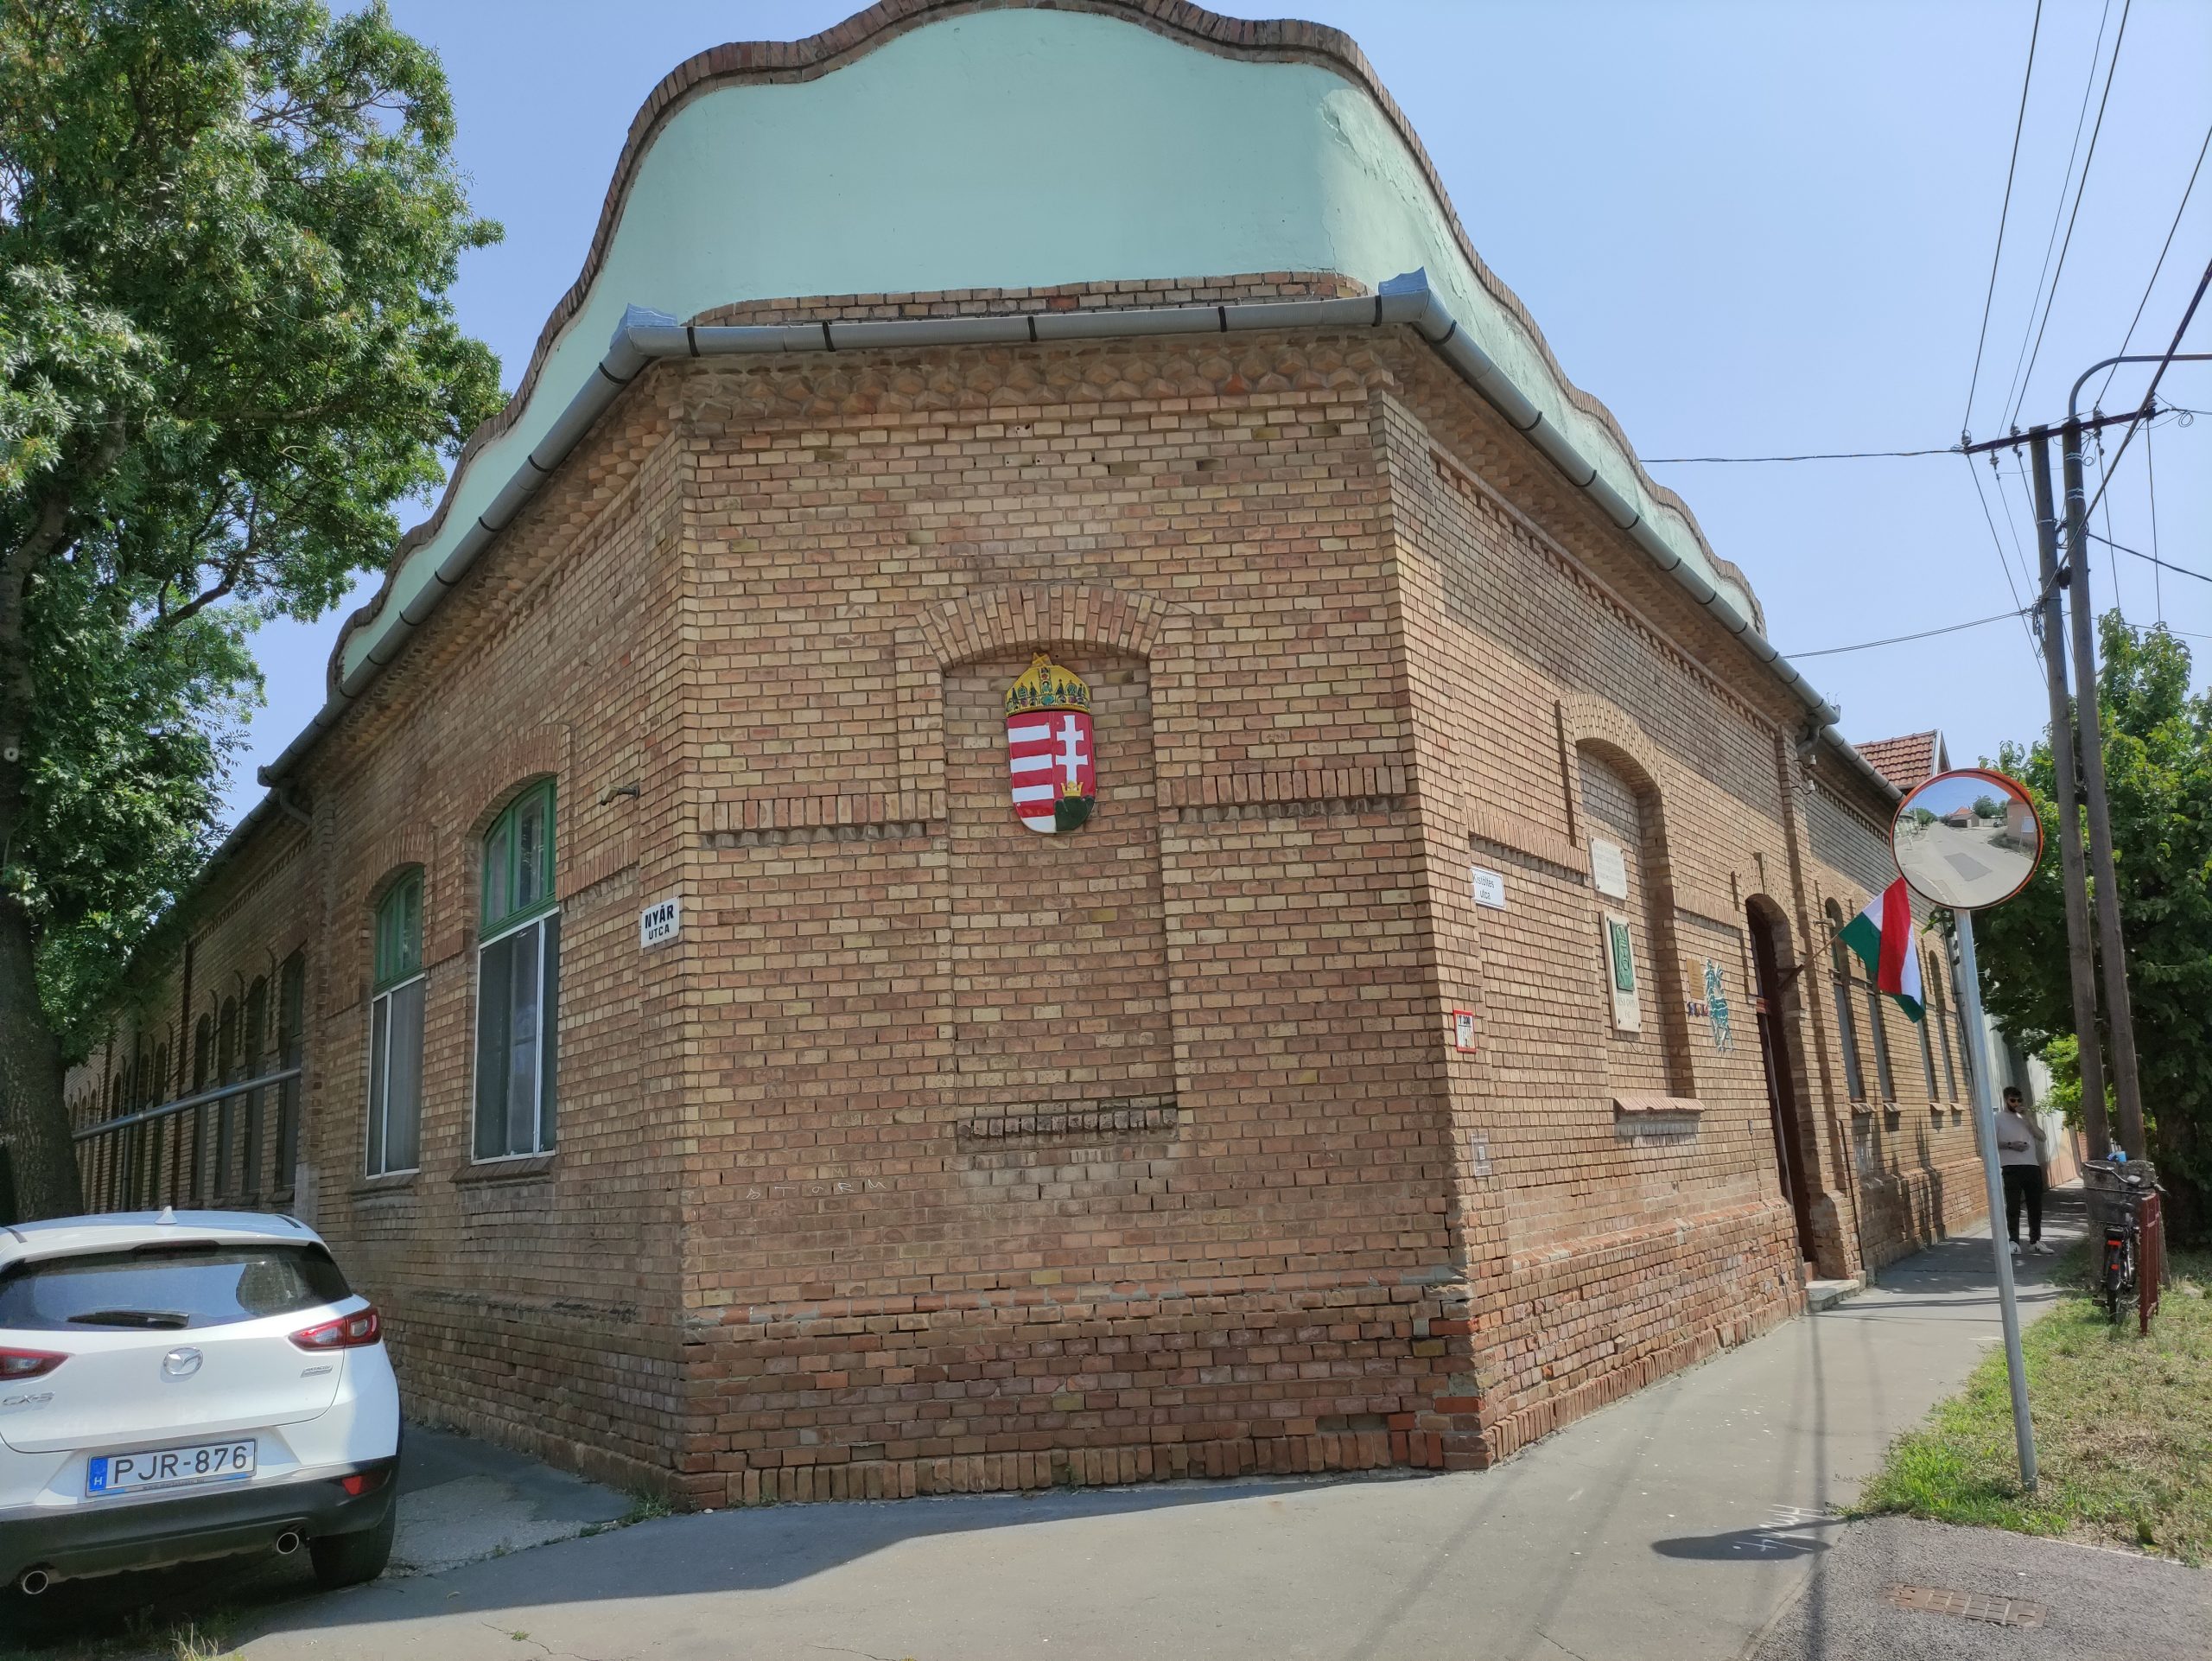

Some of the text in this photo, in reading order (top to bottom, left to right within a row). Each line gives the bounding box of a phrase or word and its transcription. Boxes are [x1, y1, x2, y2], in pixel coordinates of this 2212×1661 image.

[1479, 889, 1491, 900] utca
[645, 904, 674, 929] NYÁR
[648, 924, 670, 940] UTCA
[3, 1391, 55, 1405] CX-3
[114, 1445, 248, 1485] PJR-876
[93, 1476, 103, 1486] H
